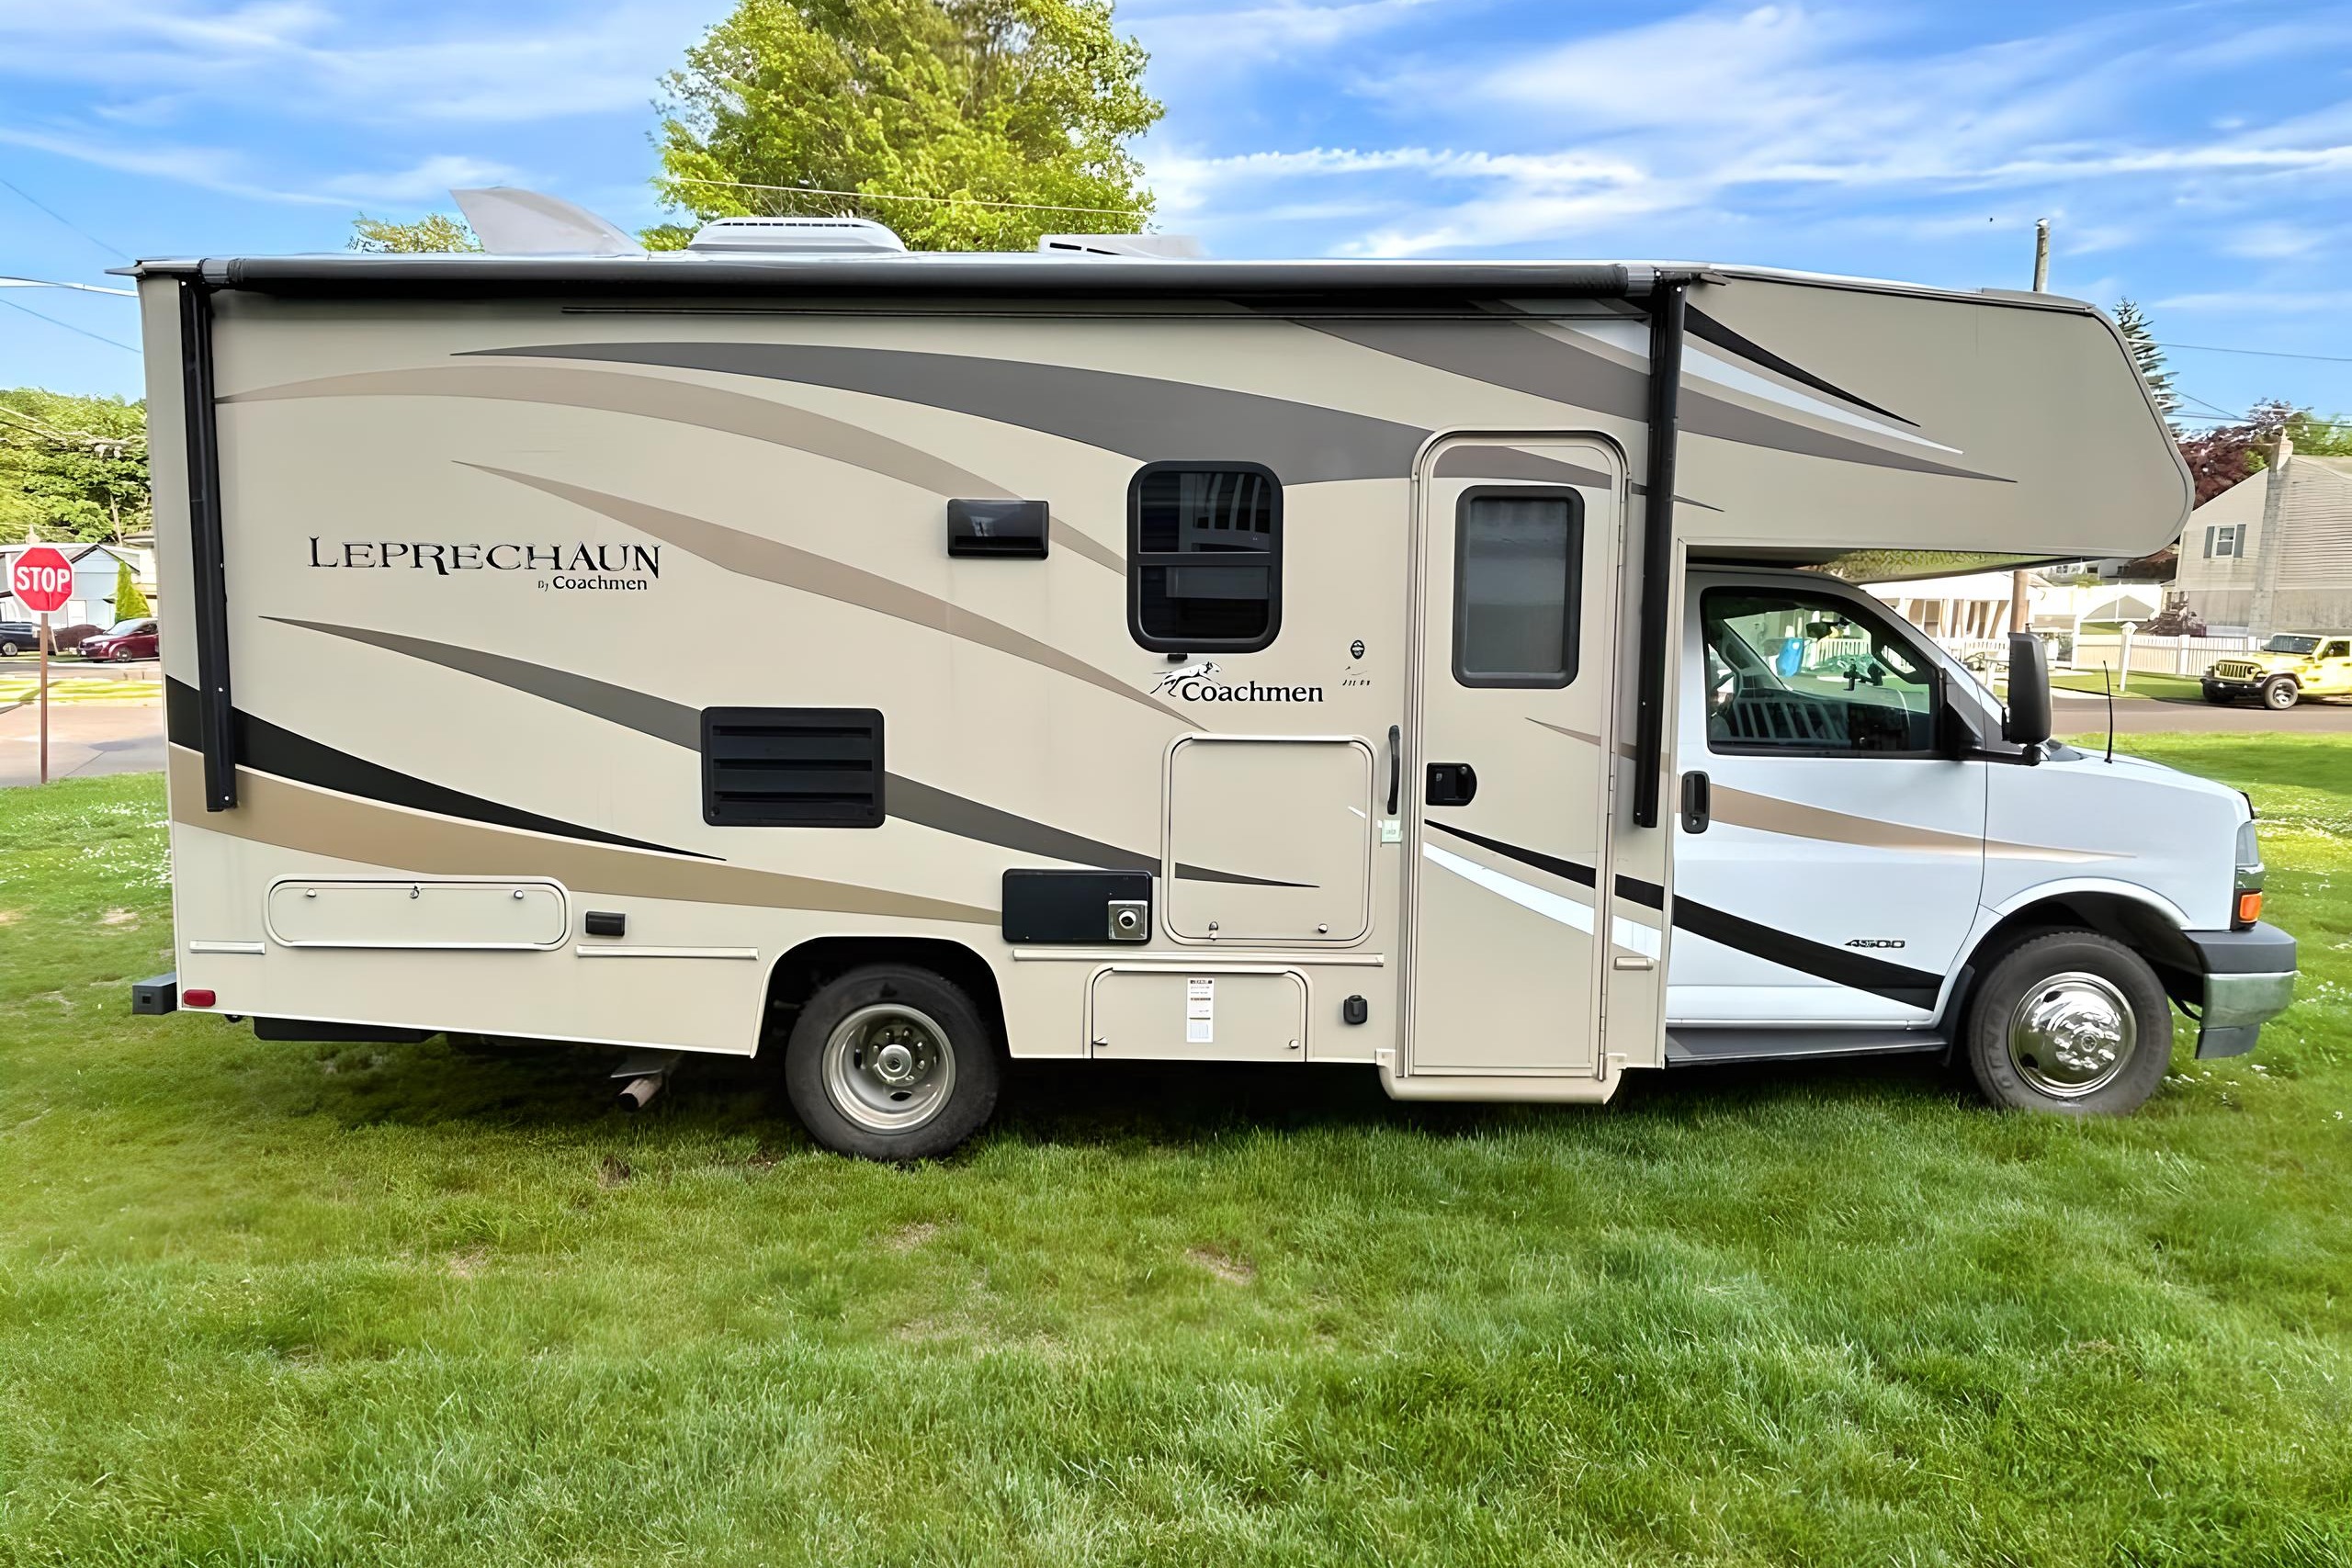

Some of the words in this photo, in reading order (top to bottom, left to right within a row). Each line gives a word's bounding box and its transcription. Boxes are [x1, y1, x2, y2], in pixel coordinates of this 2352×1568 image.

[308, 536, 662, 579] LEPRECHAUN
[17, 566, 71, 592] STOP
[552, 575, 648, 590] Coachmen
[1182, 681, 1324, 702] Coachmen
[1844, 939, 1905, 949] 4500
